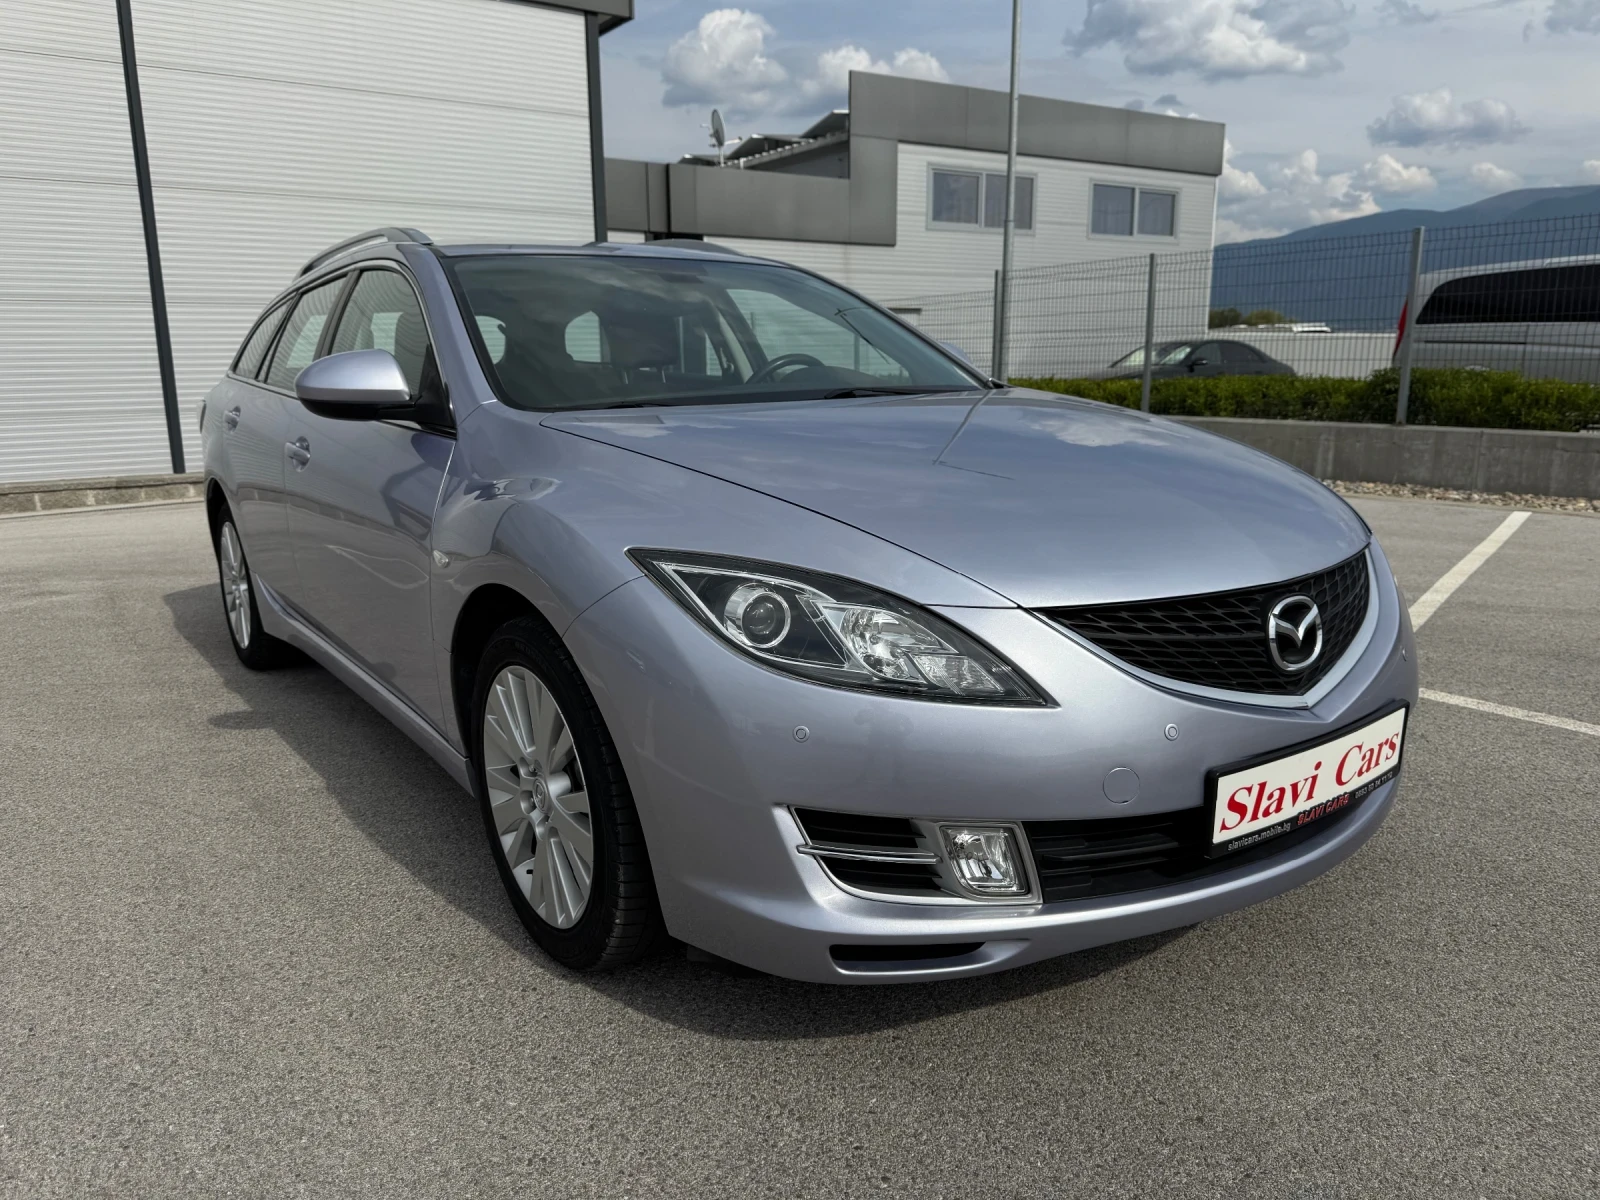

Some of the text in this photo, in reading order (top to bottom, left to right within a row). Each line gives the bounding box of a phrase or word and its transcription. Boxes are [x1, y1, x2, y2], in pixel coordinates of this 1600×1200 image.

[1219, 732, 1400, 834] Slavi Cars
[1227, 822, 1292, 851] slavicars.mobile.bg
[1297, 804, 1324, 826] SLAVI
[1325, 794, 1350, 814] CARS
